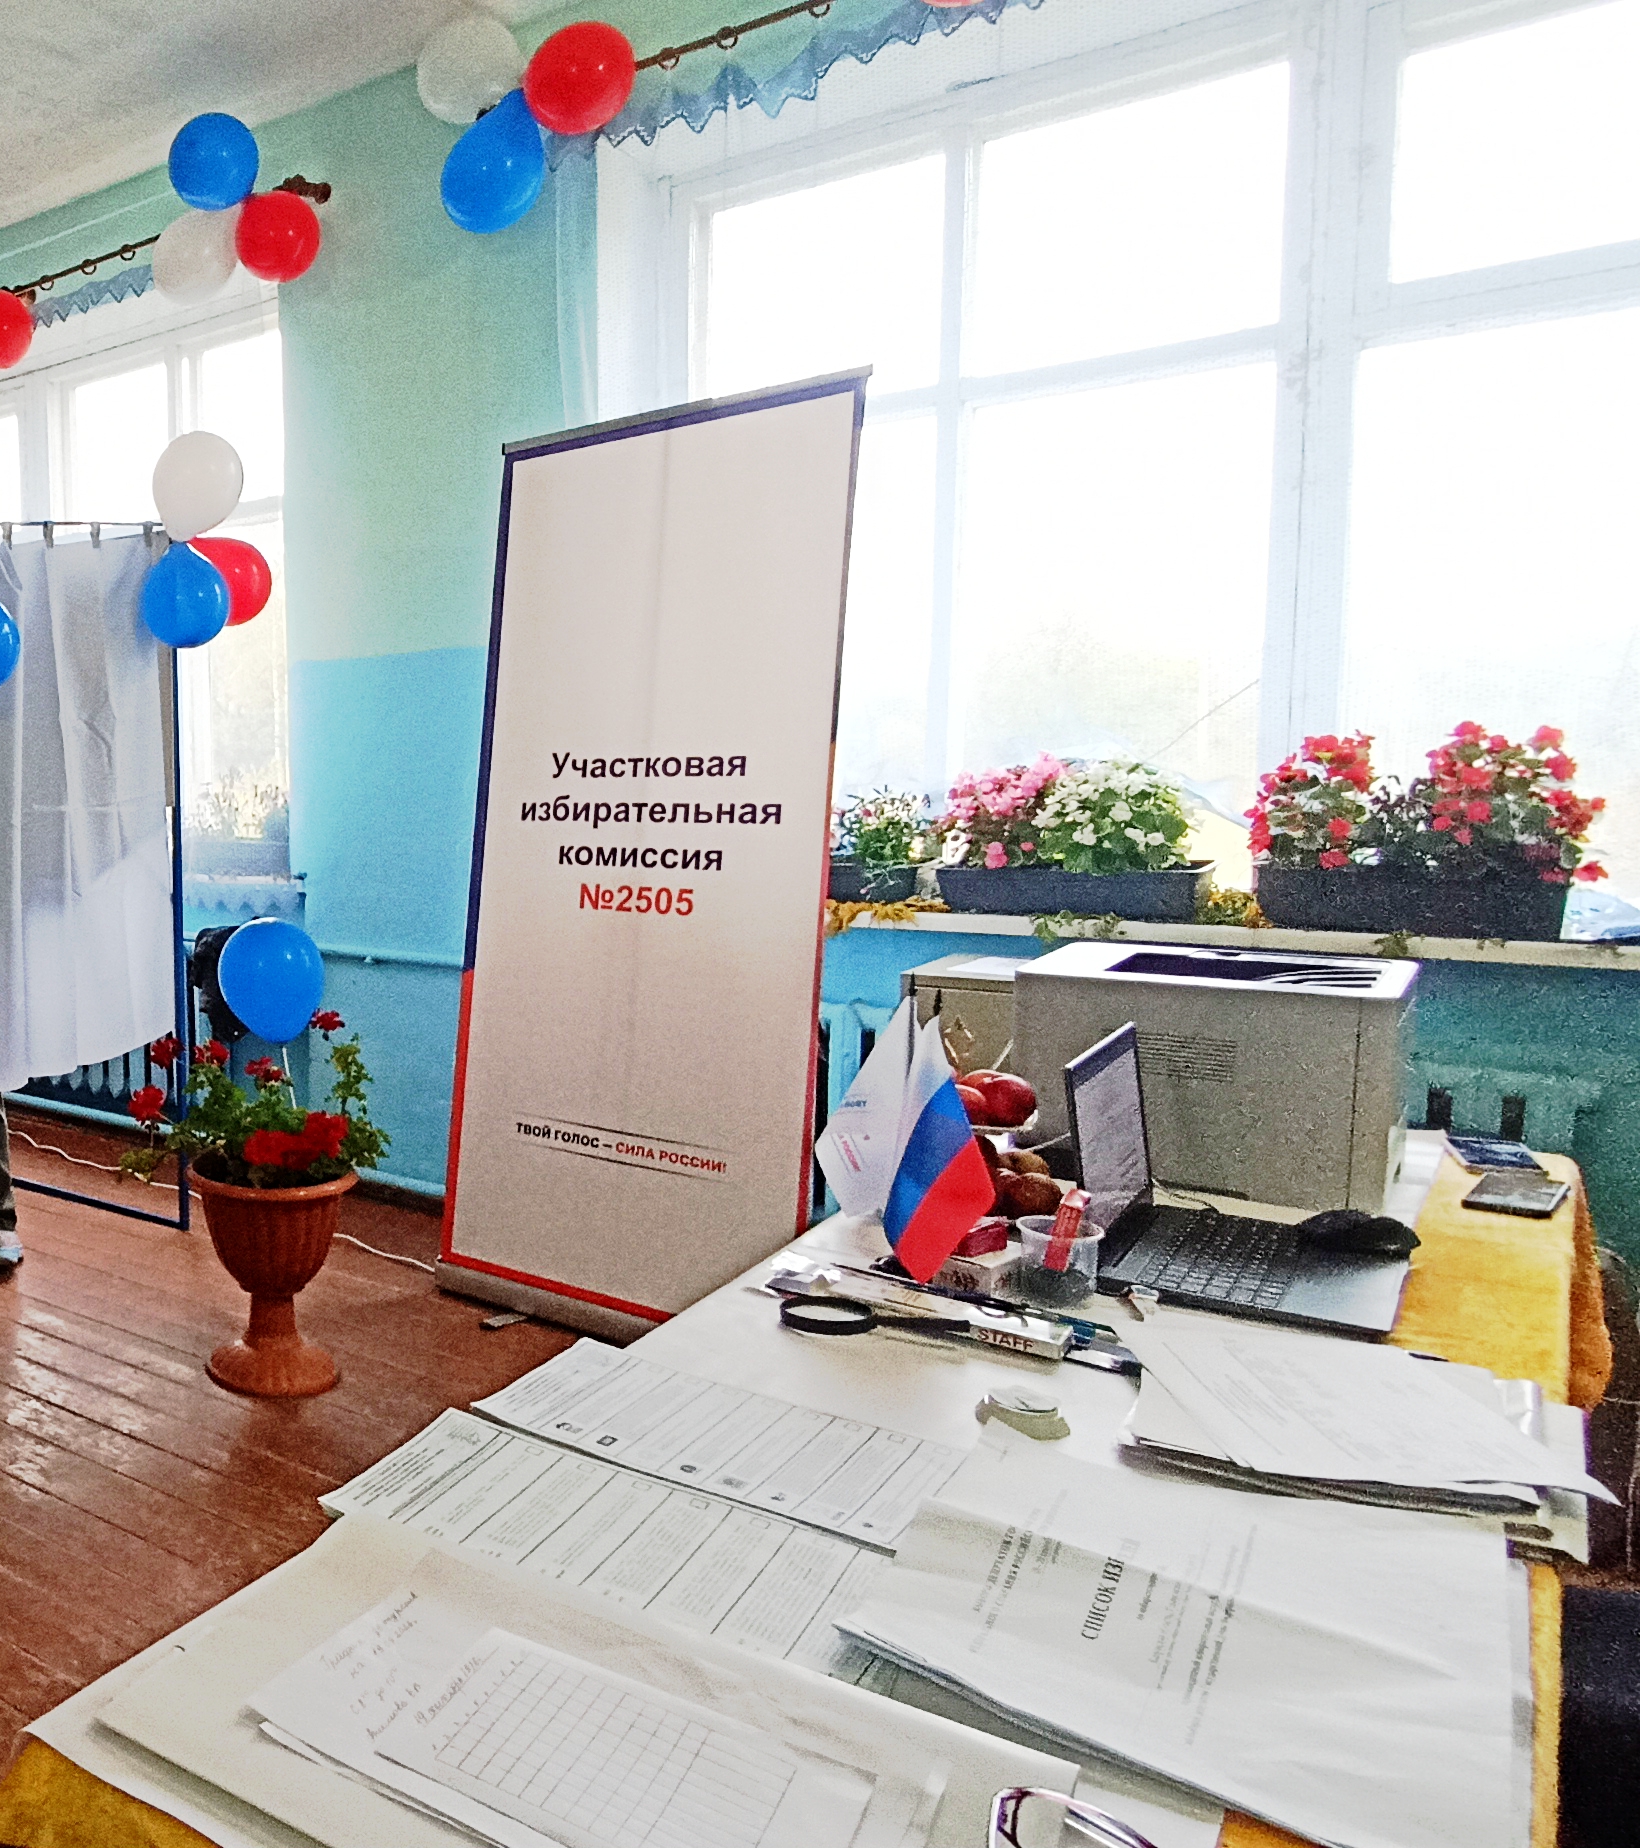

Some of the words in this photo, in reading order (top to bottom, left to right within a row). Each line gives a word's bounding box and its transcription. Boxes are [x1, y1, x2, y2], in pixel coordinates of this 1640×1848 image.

[552, 752, 747, 778] Участковая
[521, 795, 782, 829] избирательная
[558, 845, 723, 871] комиссия
[579, 883, 694, 916] №2505
[516, 1122, 551, 1139] ТВОЙ
[554, 1130, 600, 1148] ГОЛОС
[616, 1142, 655, 1160] СИЛА
[660, 1150, 727, 1174] РОССИИ!
[977, 1328, 1035, 1351] STAFF
[1081, 1583, 1117, 1640] СПИСОК
